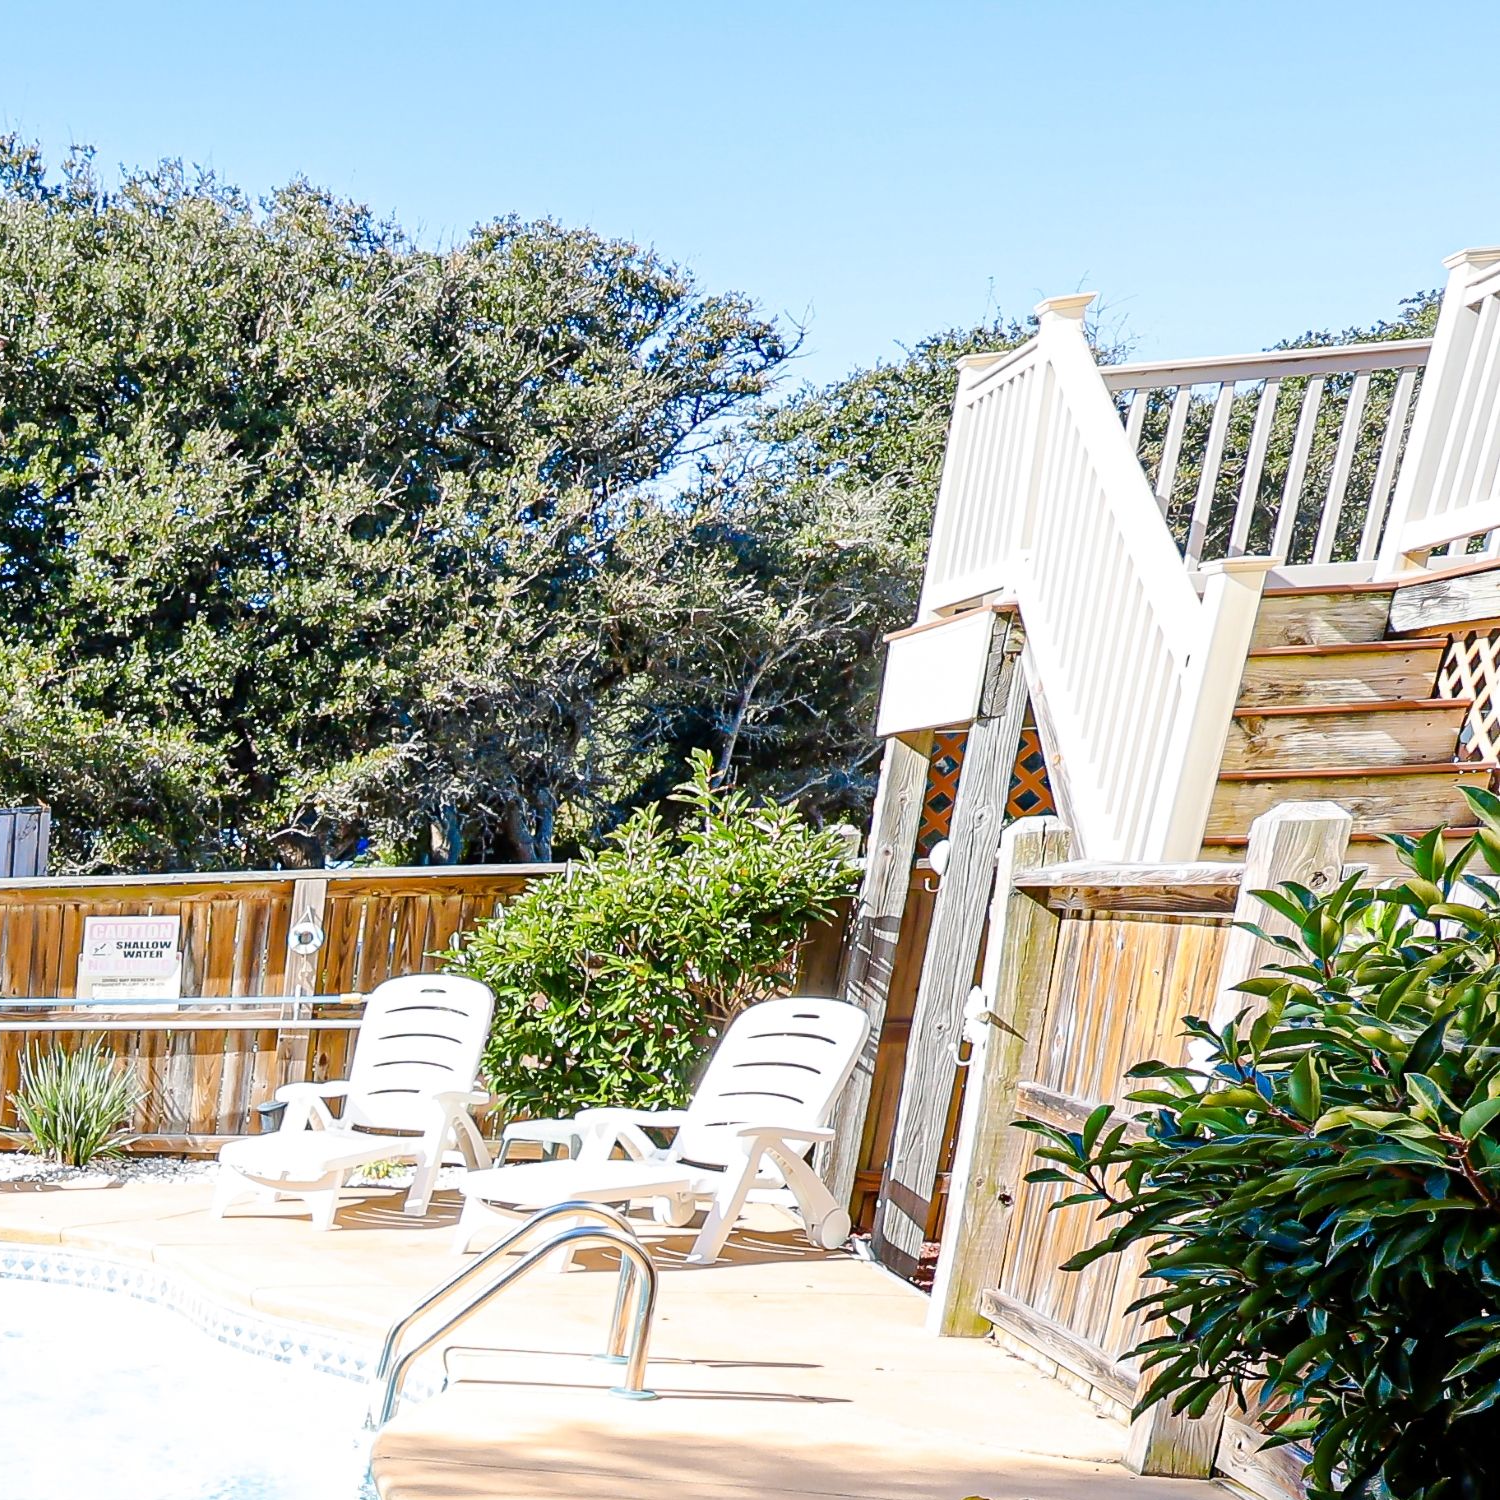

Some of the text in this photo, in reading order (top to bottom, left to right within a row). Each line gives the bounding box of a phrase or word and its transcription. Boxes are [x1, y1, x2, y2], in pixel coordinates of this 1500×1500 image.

[93, 924, 171, 939] CAUTION
[115, 941, 172, 950] SHALLOW
[123, 950, 163, 959] WATER
